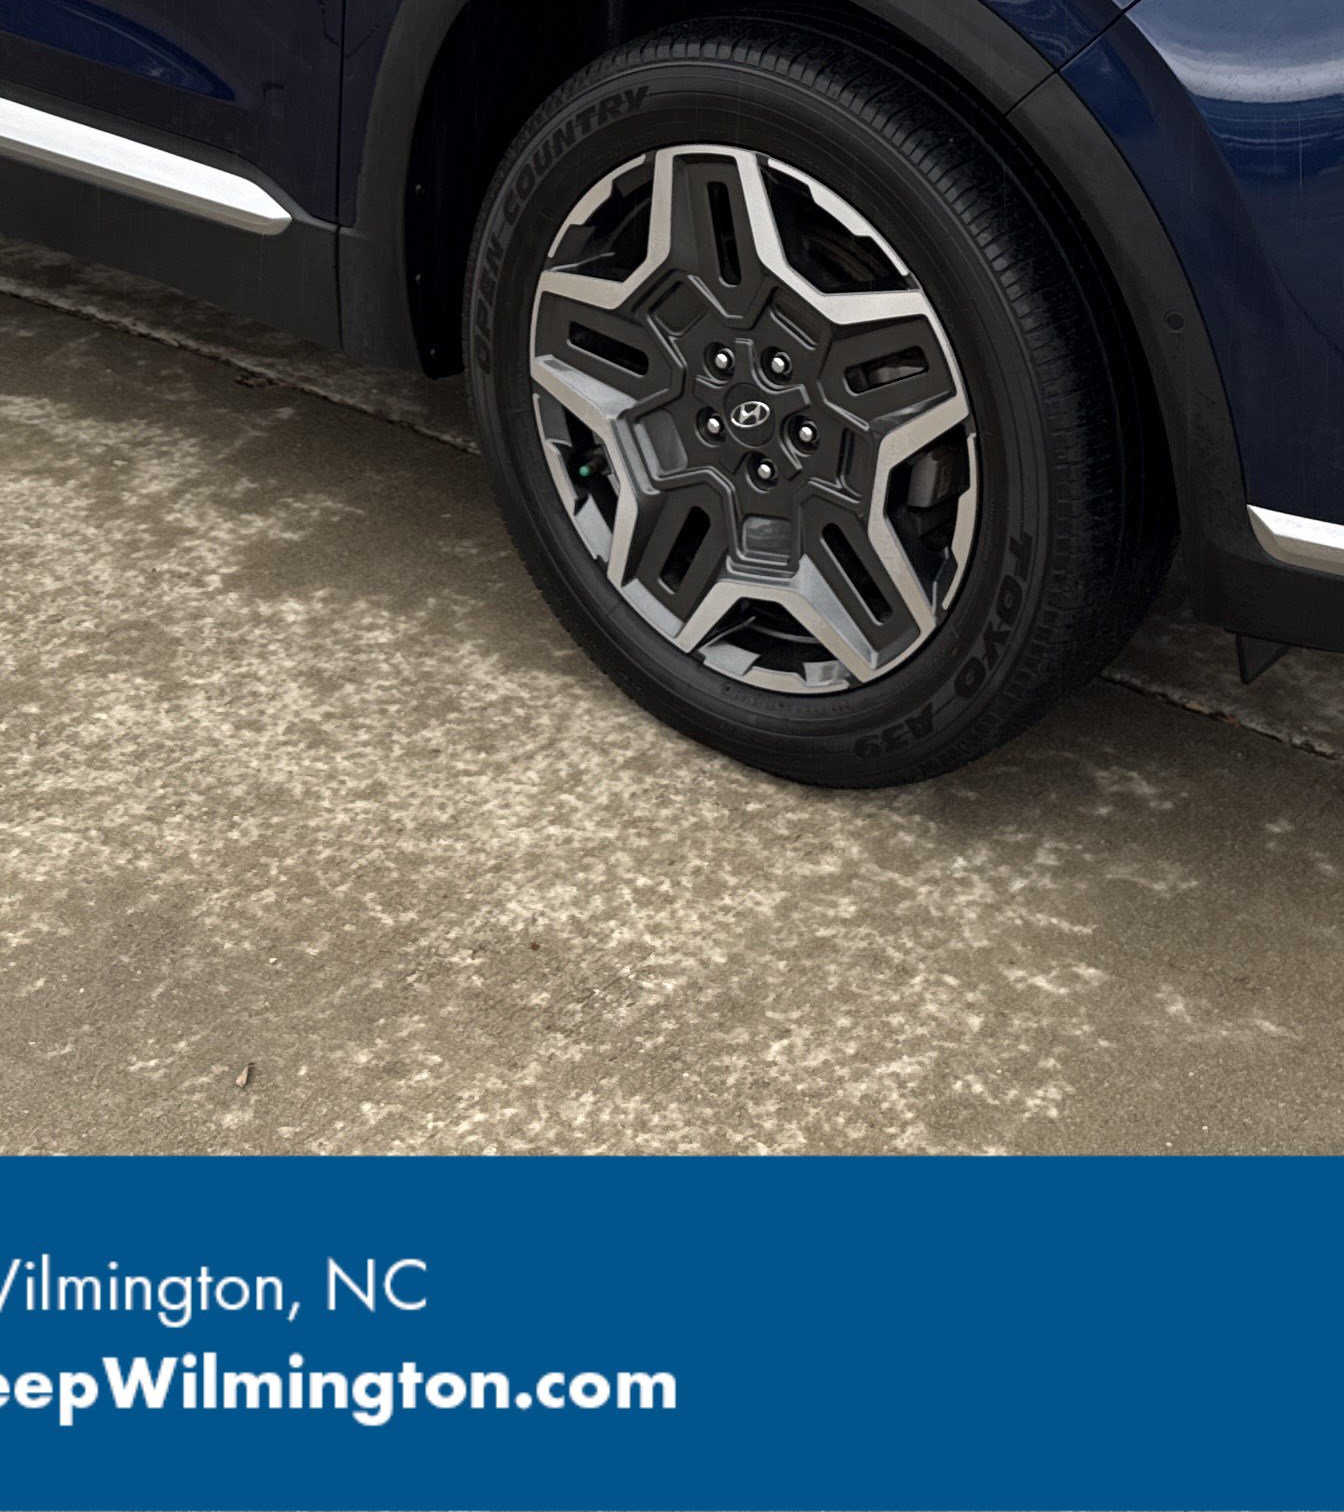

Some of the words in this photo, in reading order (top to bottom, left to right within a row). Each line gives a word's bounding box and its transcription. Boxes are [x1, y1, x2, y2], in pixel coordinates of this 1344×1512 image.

[474, 231, 505, 376] OPEN
[503, 85, 650, 227] COUNTRY
[954, 532, 1033, 700] TOYO
